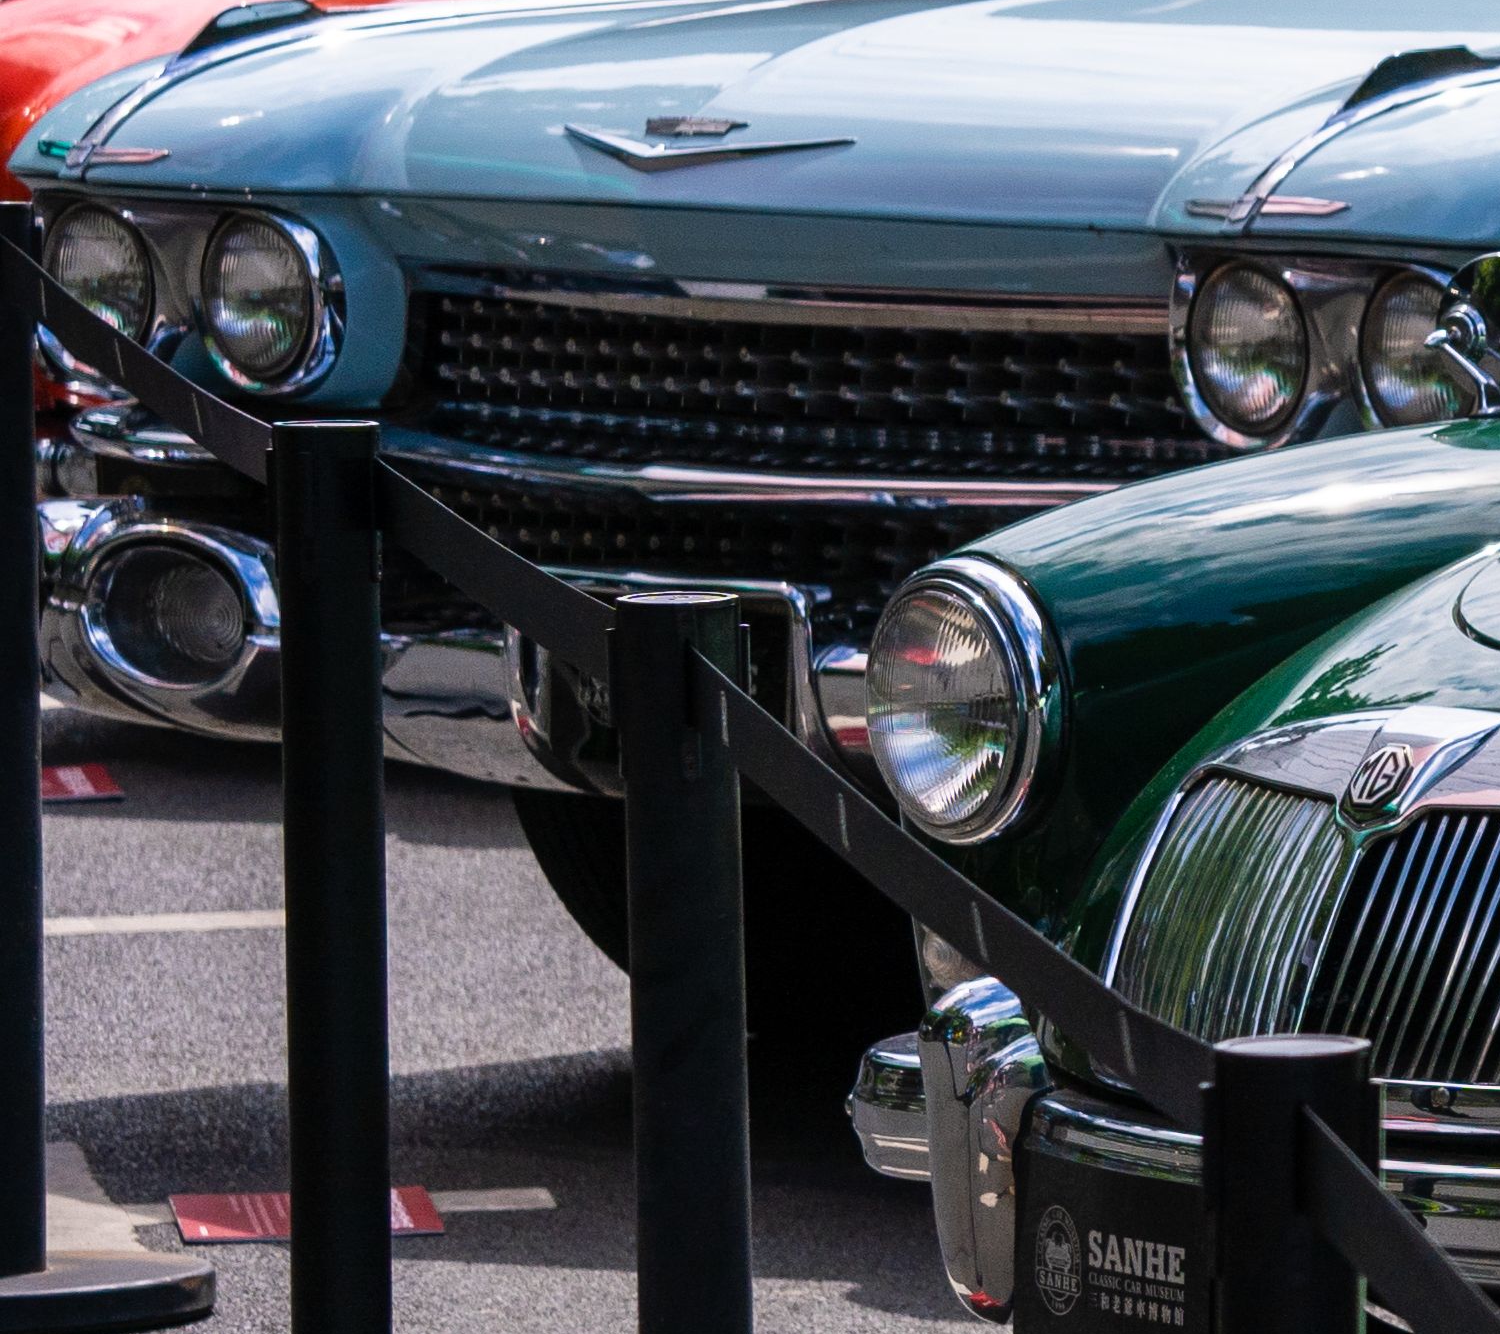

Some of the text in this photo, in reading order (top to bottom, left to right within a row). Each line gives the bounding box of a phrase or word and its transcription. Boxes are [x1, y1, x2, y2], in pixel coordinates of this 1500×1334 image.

[1352, 749, 1402, 800] MG
[1088, 1229, 1186, 1285] SANHE
[1040, 1270, 1078, 1292] SANHE
[1088, 1272, 1185, 1303] CLASSIC CAR MUSEUM
